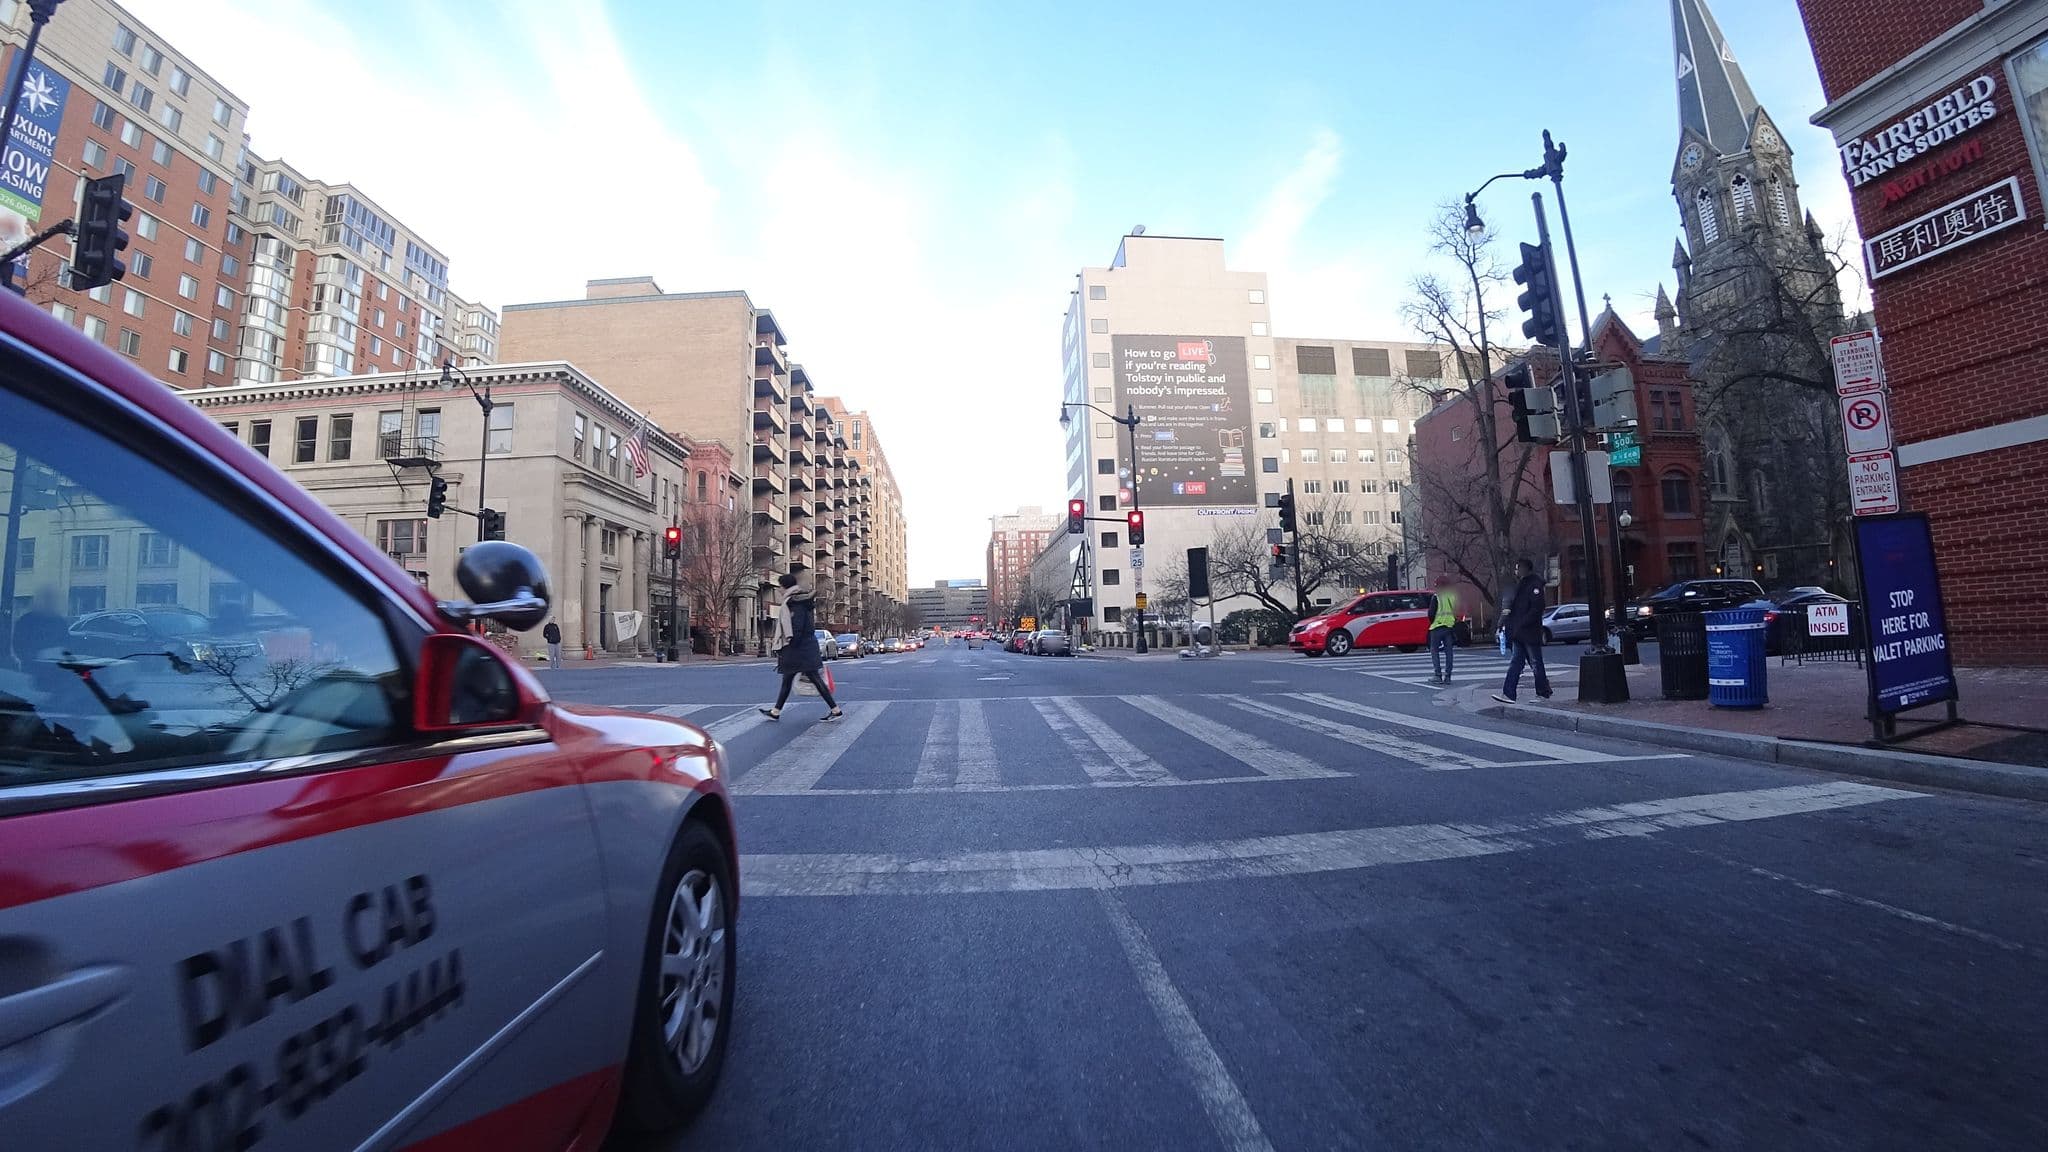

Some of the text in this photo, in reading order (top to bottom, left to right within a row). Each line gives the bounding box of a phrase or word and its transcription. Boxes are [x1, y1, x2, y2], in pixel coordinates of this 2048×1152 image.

[1840, 75, 1997, 174] FAIRFIELD
[1851, 101, 1997, 187] INN & SUITES
[1124, 347, 1204, 360] How to go LIVE
[1125, 361, 1206, 373] if you're reading
[1125, 373, 1226, 385] Tolstoy in public and
[1126, 385, 1227, 397] nobody's impressed.
[1862, 462, 1879, 472] NO
[1855, 472, 1890, 484] PARKING
[1856, 483, 1892, 496] ENTRANCE
[1132, 558, 1143, 567] 25
[1889, 589, 1914, 608] STOP
[1815, 606, 1838, 617] ATM
[1810, 622, 1846, 633] INSIDE
[1881, 611, 1930, 635] HERE FOR
[1873, 633, 1945, 663] VALET PARKING
[175, 873, 438, 1056] DIAL CAB
